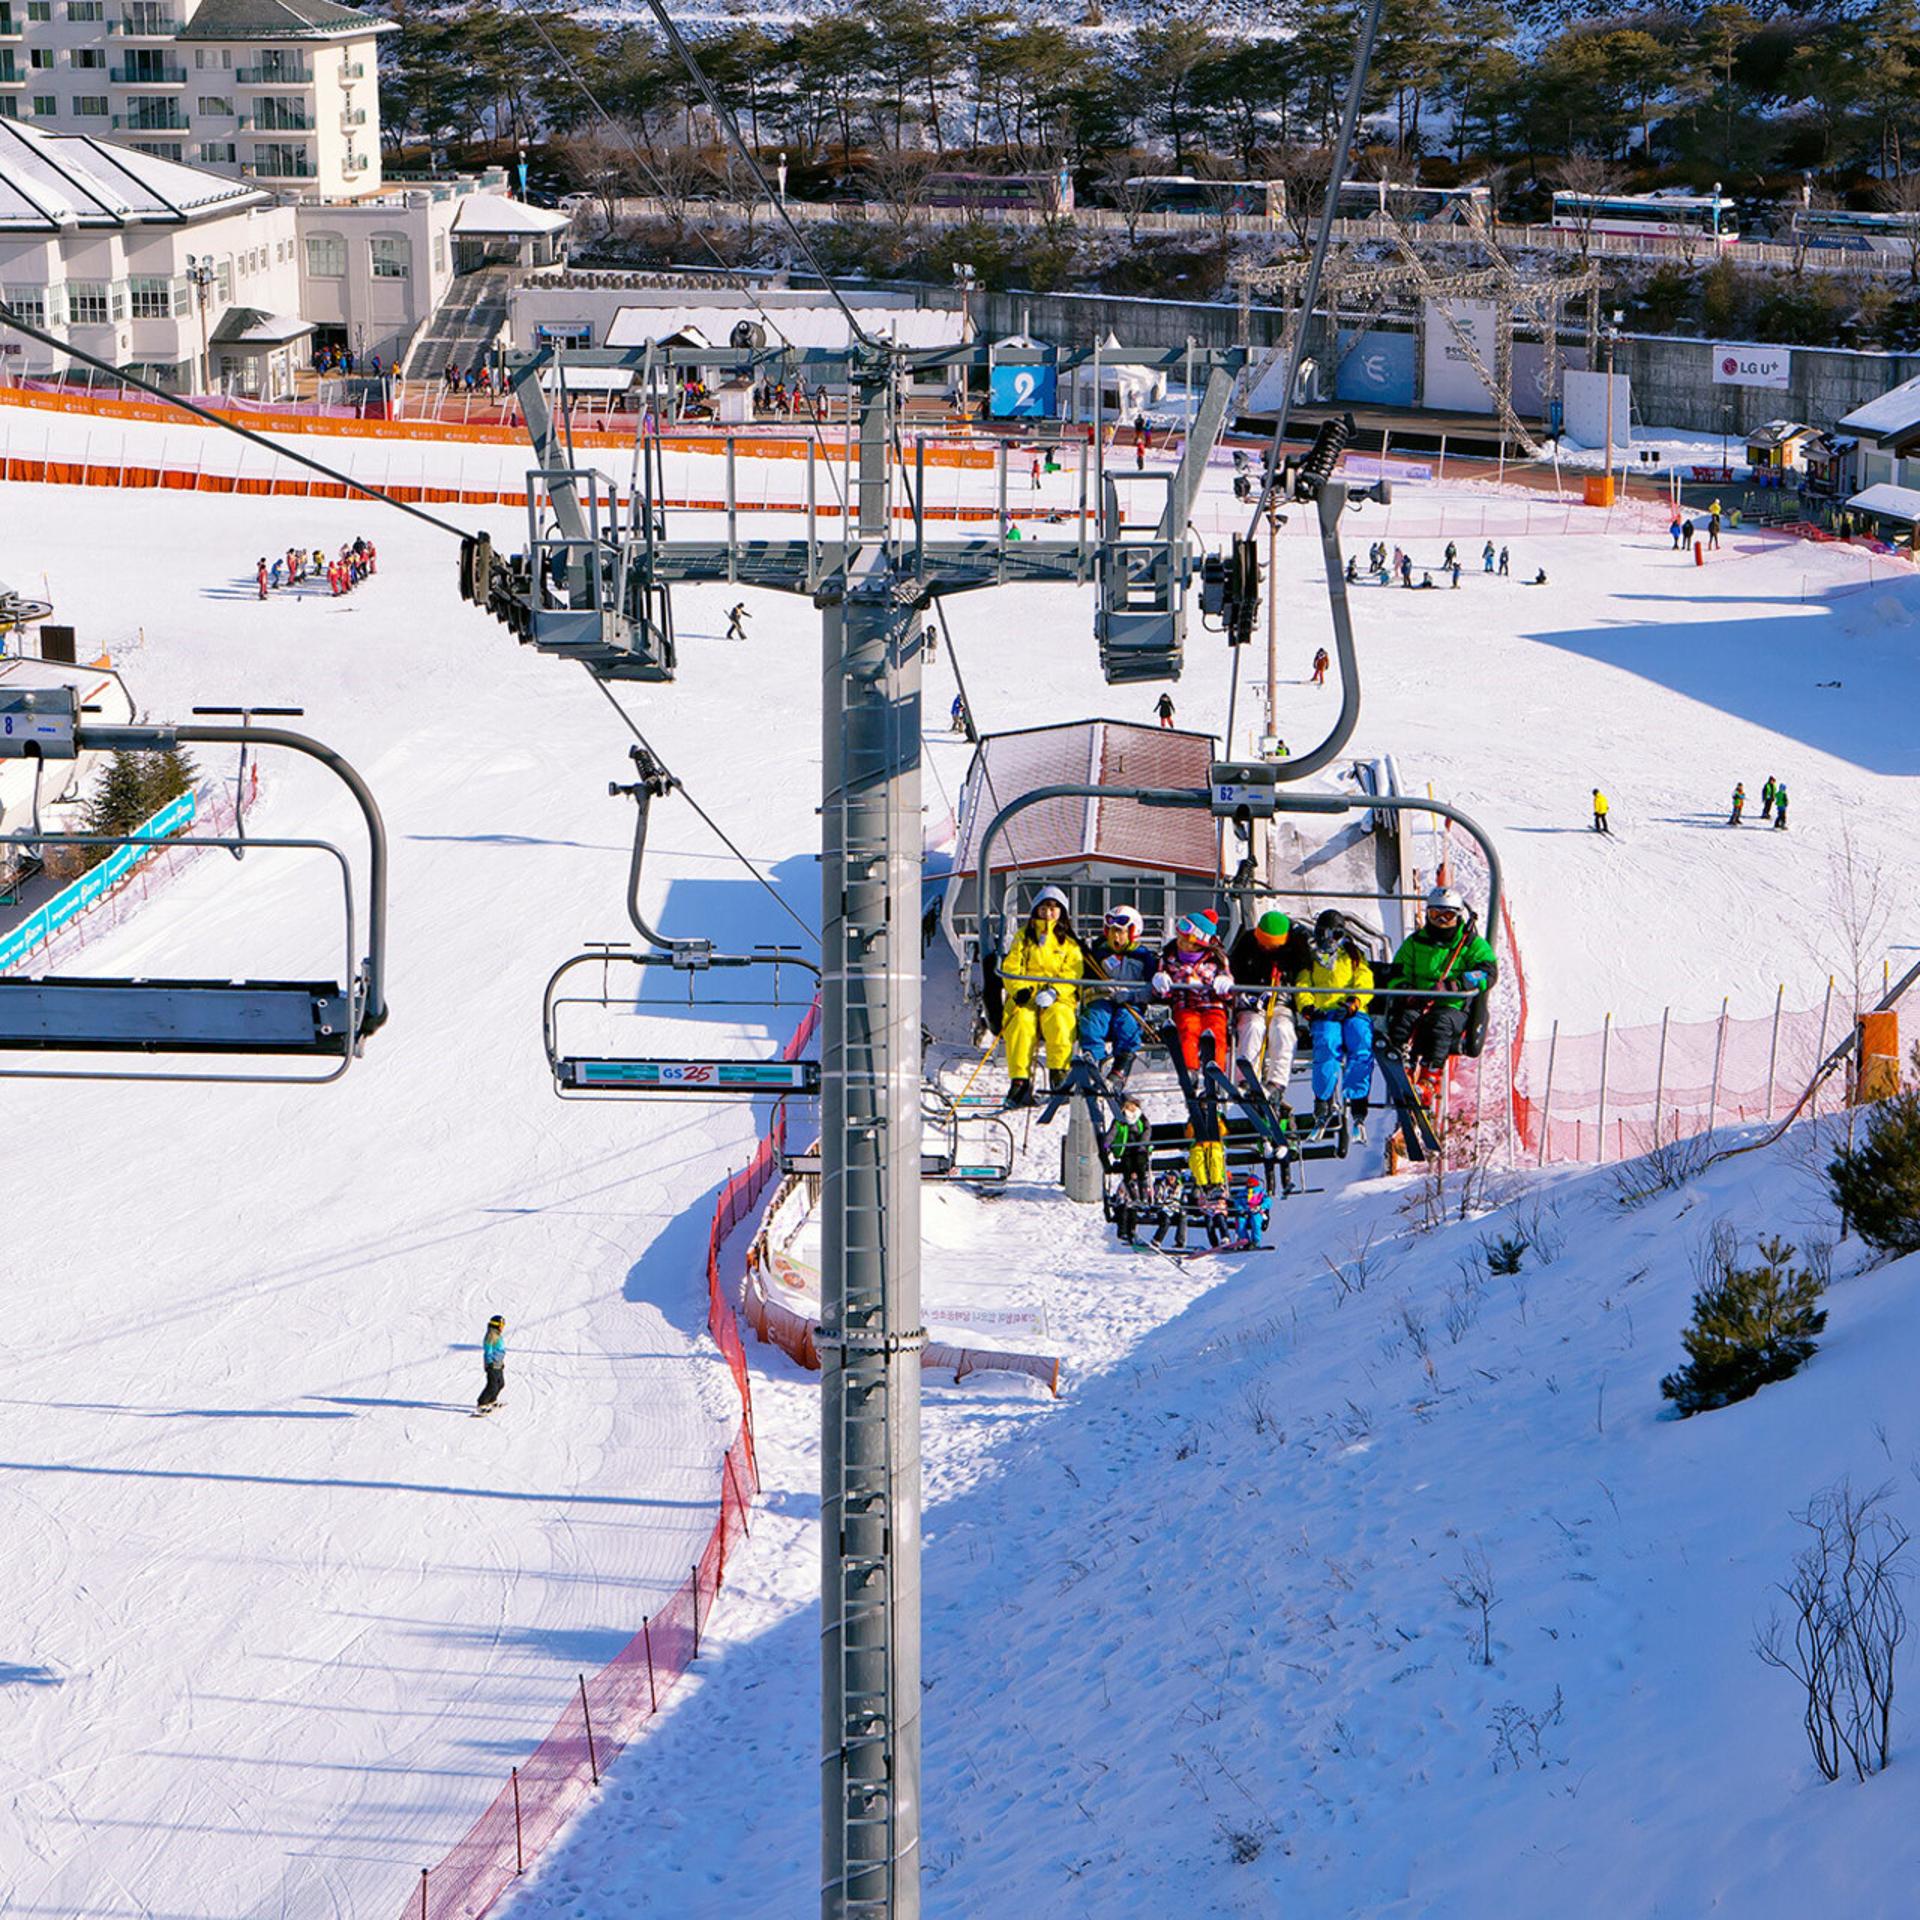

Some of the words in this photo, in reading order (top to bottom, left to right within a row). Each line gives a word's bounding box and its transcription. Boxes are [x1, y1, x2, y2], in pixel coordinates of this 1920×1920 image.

[1740, 362, 1758, 374] LG
[1761, 361, 1779, 375] U+
[1014, 372, 1036, 407] 2
[4, 715, 13, 735] 8
[1220, 786, 1233, 801] 62
[662, 1065, 714, 1082] GS25
